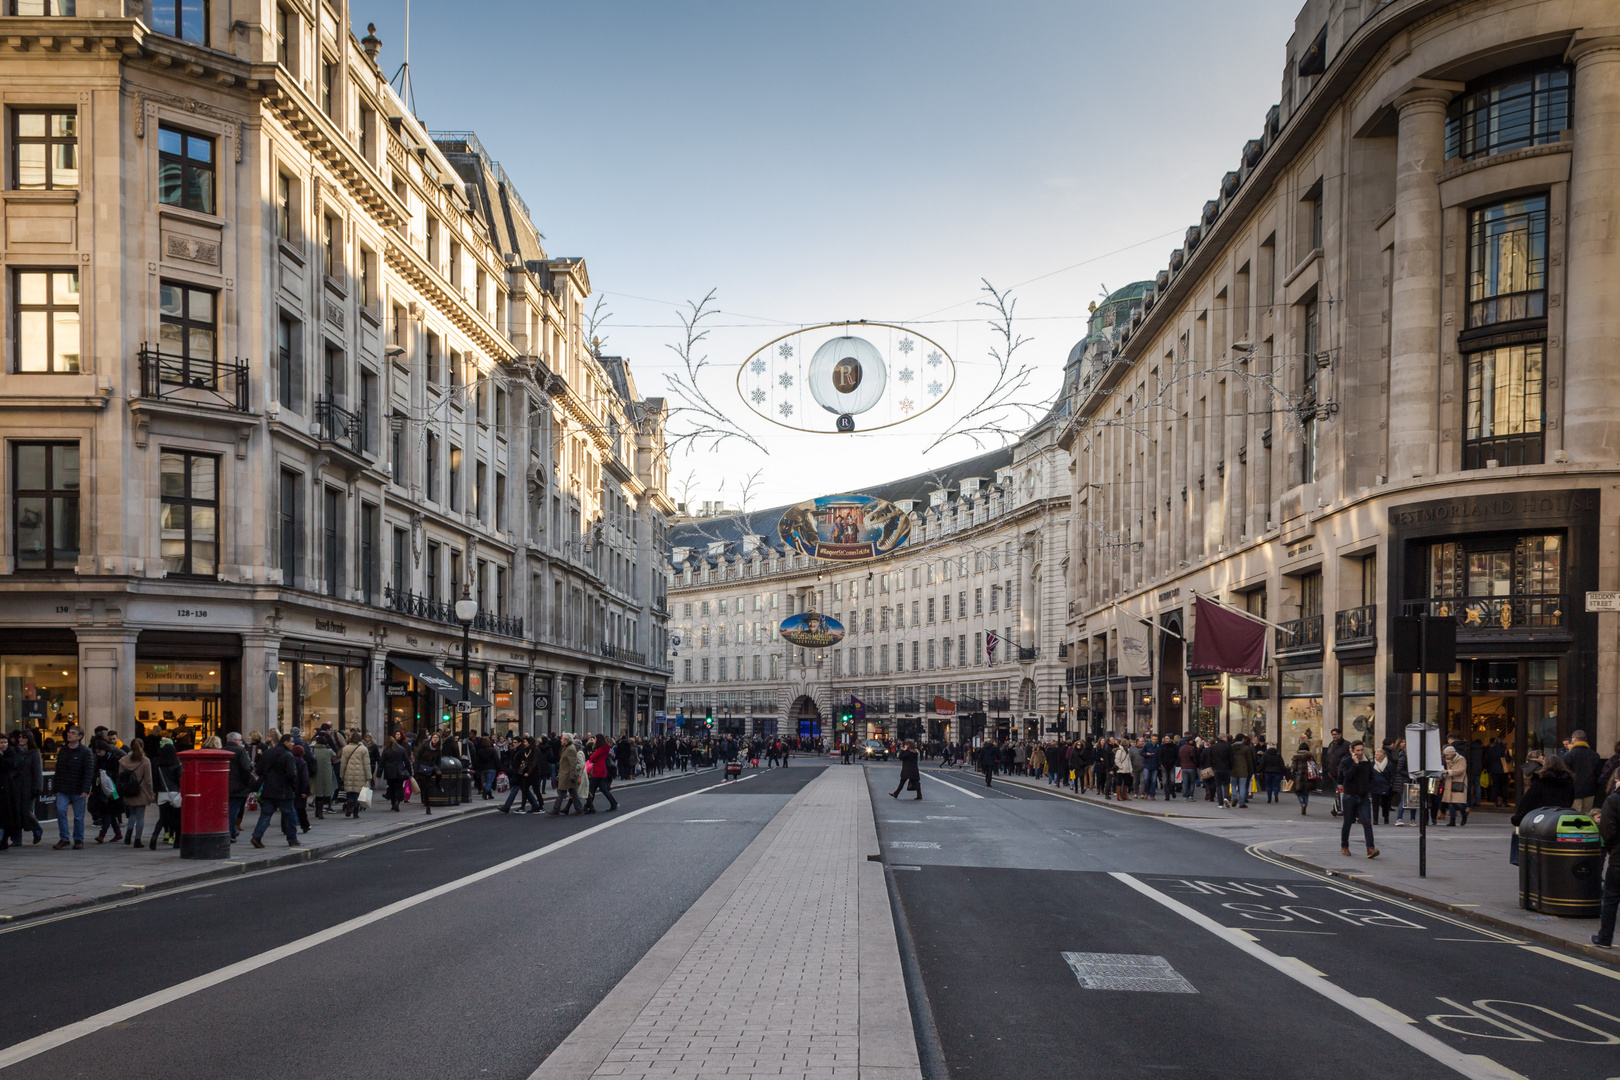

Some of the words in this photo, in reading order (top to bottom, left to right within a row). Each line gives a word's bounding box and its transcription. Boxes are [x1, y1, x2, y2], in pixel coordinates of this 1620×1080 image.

[839, 365, 856, 386] R
[842, 419, 849, 427] R
[1389, 500, 1514, 525] WESTMORLAND
[1522, 497, 1595, 514] HOUSE
[177, 610, 208, 618] 128-130
[1226, 667, 1259, 675] HOME
[1221, 902, 1427, 930] BUS
